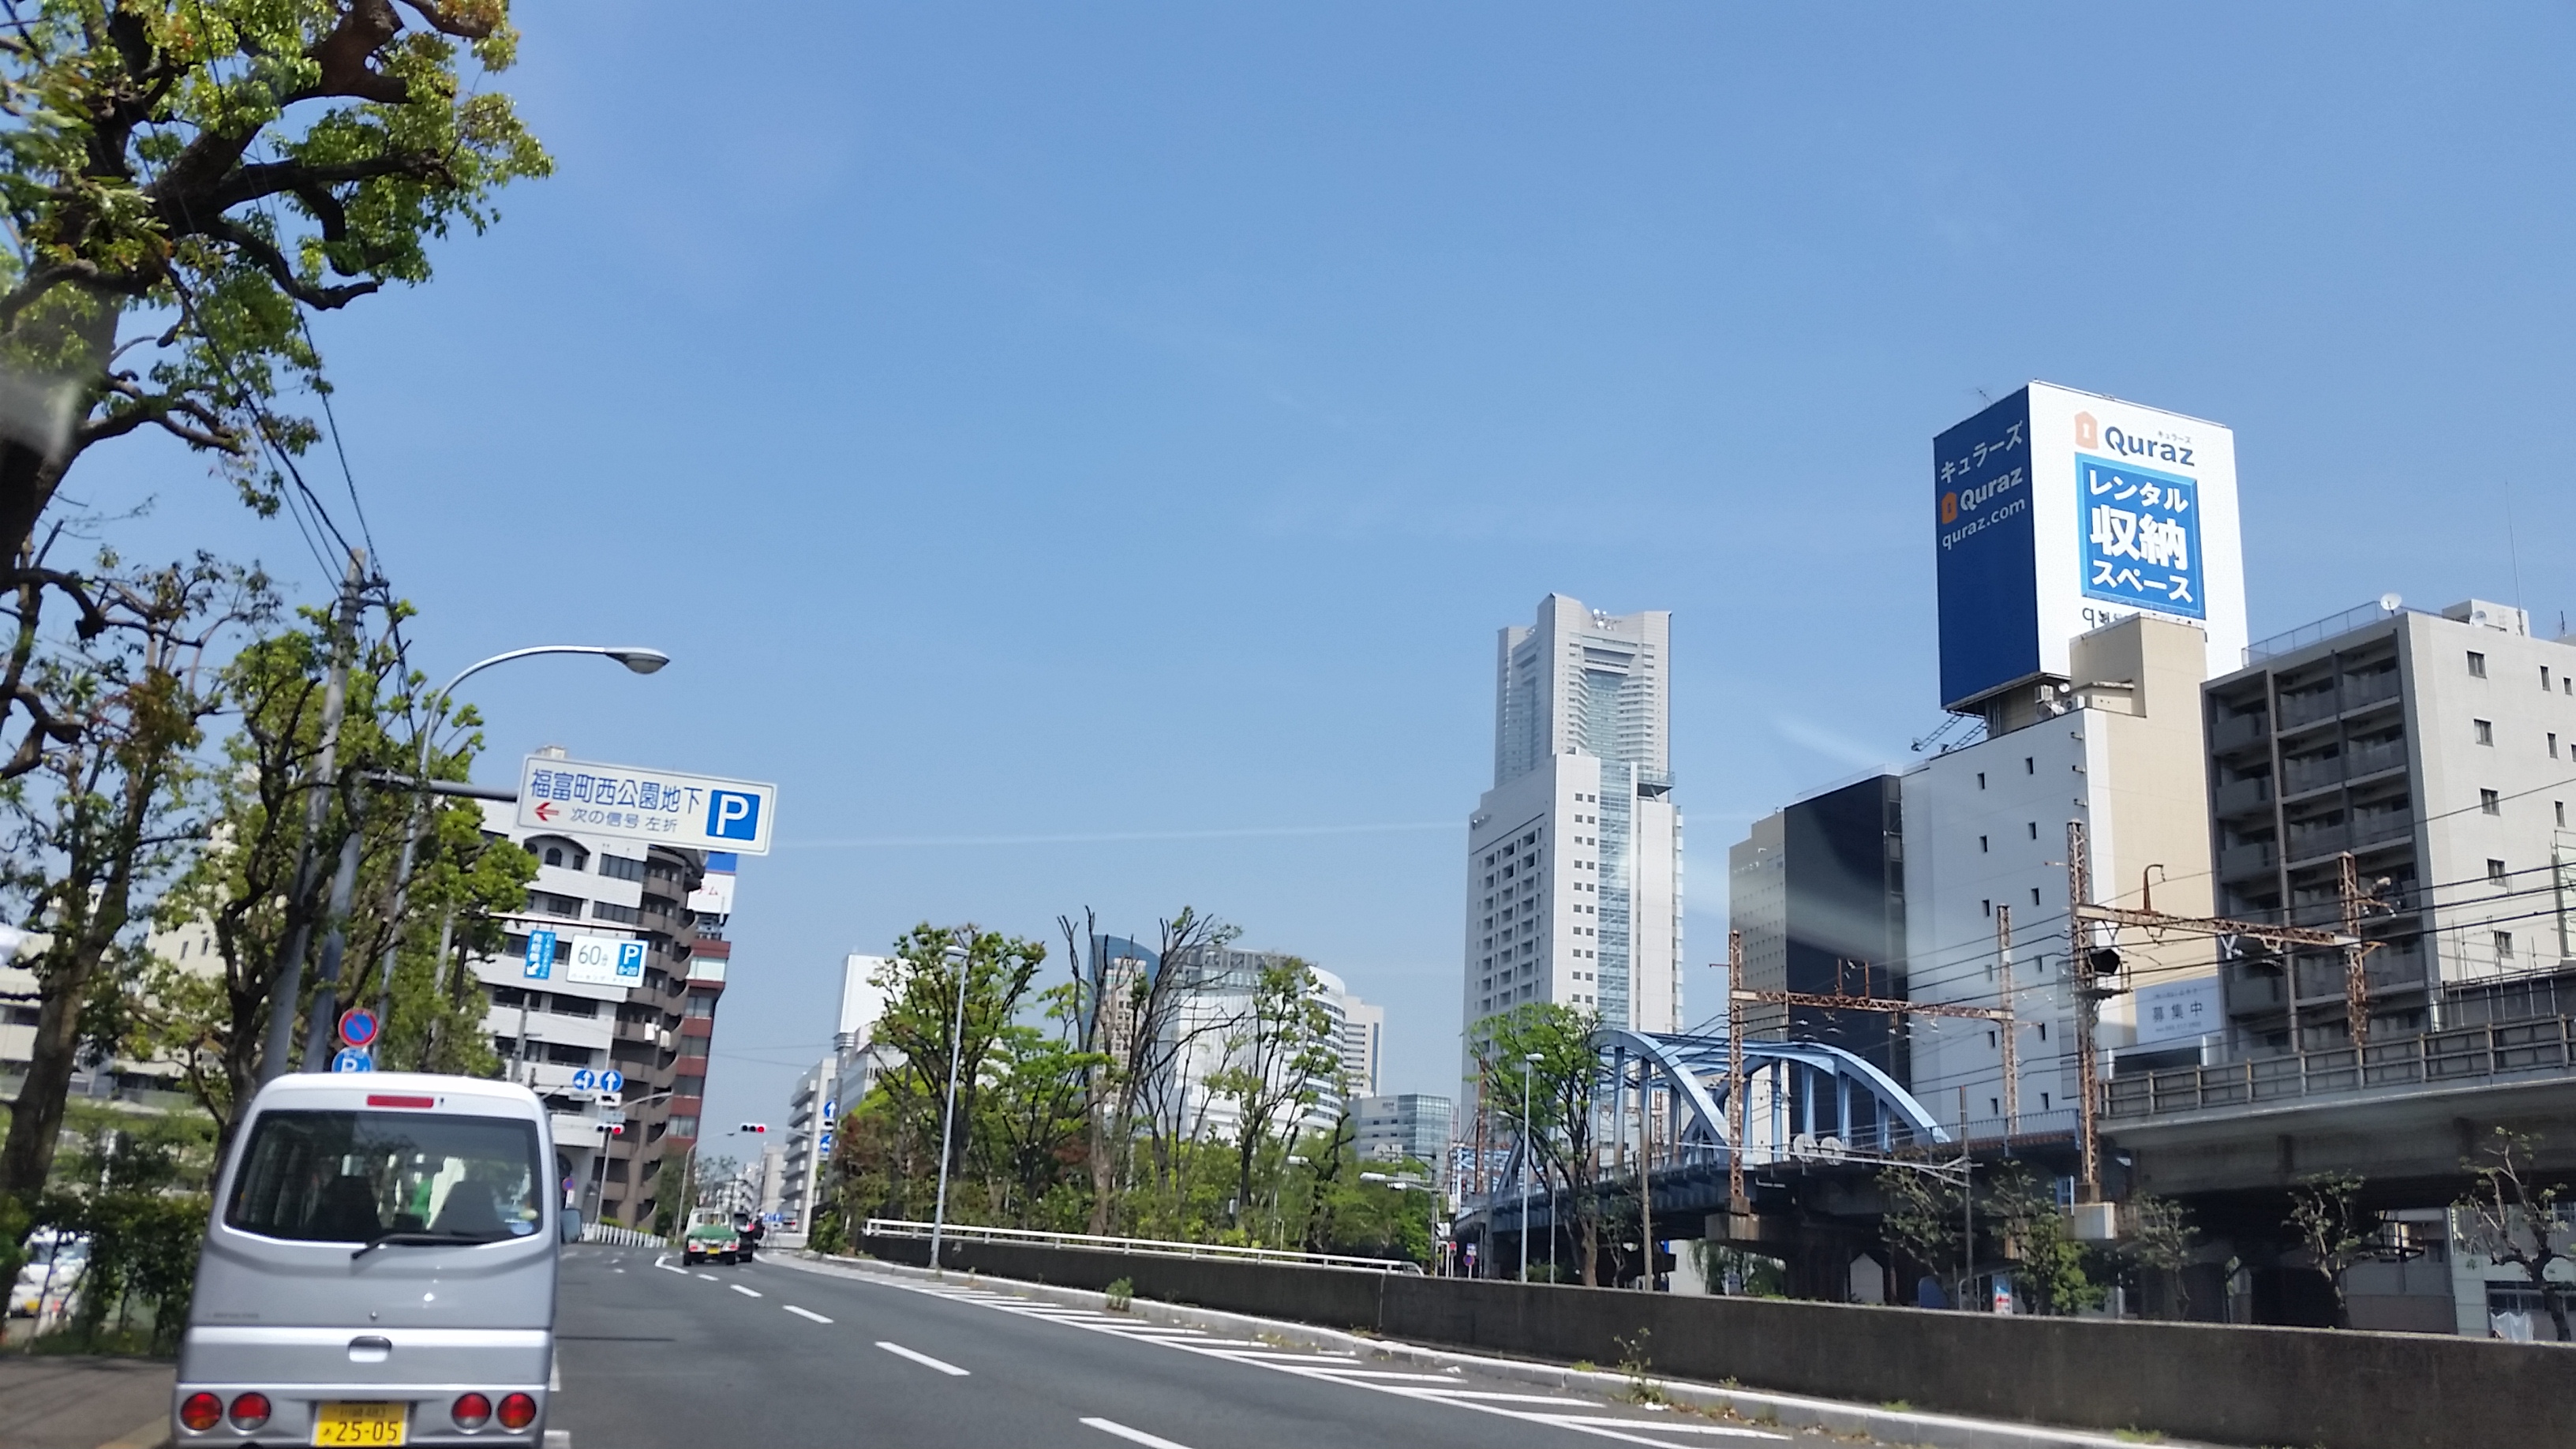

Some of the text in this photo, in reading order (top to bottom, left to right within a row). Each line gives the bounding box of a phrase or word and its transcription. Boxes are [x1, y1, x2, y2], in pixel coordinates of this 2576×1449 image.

[1941, 420, 2023, 484] キュラーズ
[2105, 426, 2195, 466] Quraz
[1960, 466, 2023, 511] Quraz
[2089, 469, 2189, 513] レンタル
[1942, 498, 2026, 551] quraz.com
[2089, 504, 2188, 571] 収納
[2091, 560, 2193, 604] スペース
[531, 769, 702, 814] 福富町西公園地下
[716, 793, 750, 836] P
[623, 945, 639, 965] P
[2154, 1001, 2202, 1021] 募集中
[336, 1421, 399, 1442] 25-05
